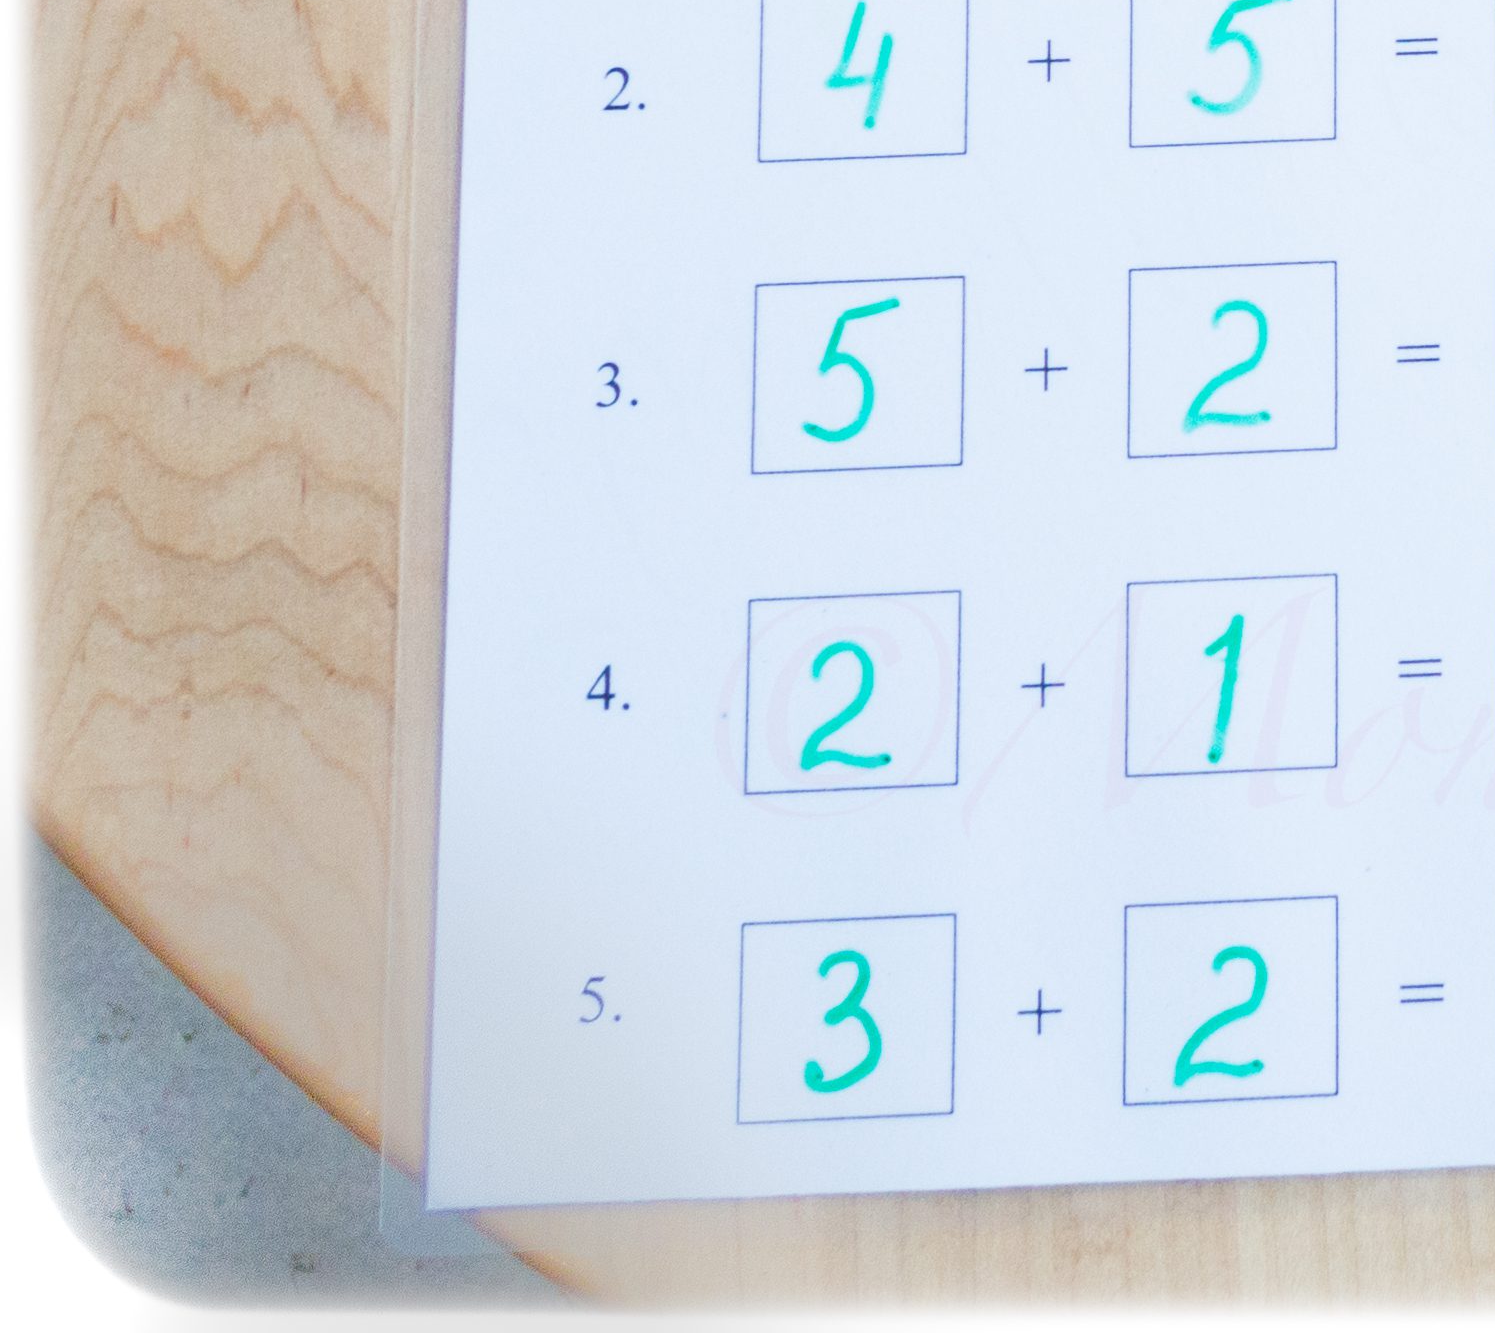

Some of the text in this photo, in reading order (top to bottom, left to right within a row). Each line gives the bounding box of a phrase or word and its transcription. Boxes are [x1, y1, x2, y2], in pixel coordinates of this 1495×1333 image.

[603, 65, 646, 112] 2.
[823, 0, 894, 131] 4
[1028, 40, 1070, 82] +
[1396, 37, 1438, 56] =
[595, 360, 639, 409] 3.
[800, 295, 902, 445] 5
[1025, 348, 1068, 391] +
[1181, 298, 1272, 434] 2
[1397, 344, 1440, 363] =
[585, 664, 631, 712] 4.
[798, 639, 894, 772] 2
[1022, 664, 1065, 707] +
[1202, 612, 1246, 766] 1
[1399, 658, 1442, 678] =
[579, 976, 622, 1024] 5.
[802, 947, 884, 1096] 3
[1018, 990, 1062, 1035] +
[1171, 943, 1270, 1090] 2
[1400, 983, 1444, 1004] =
